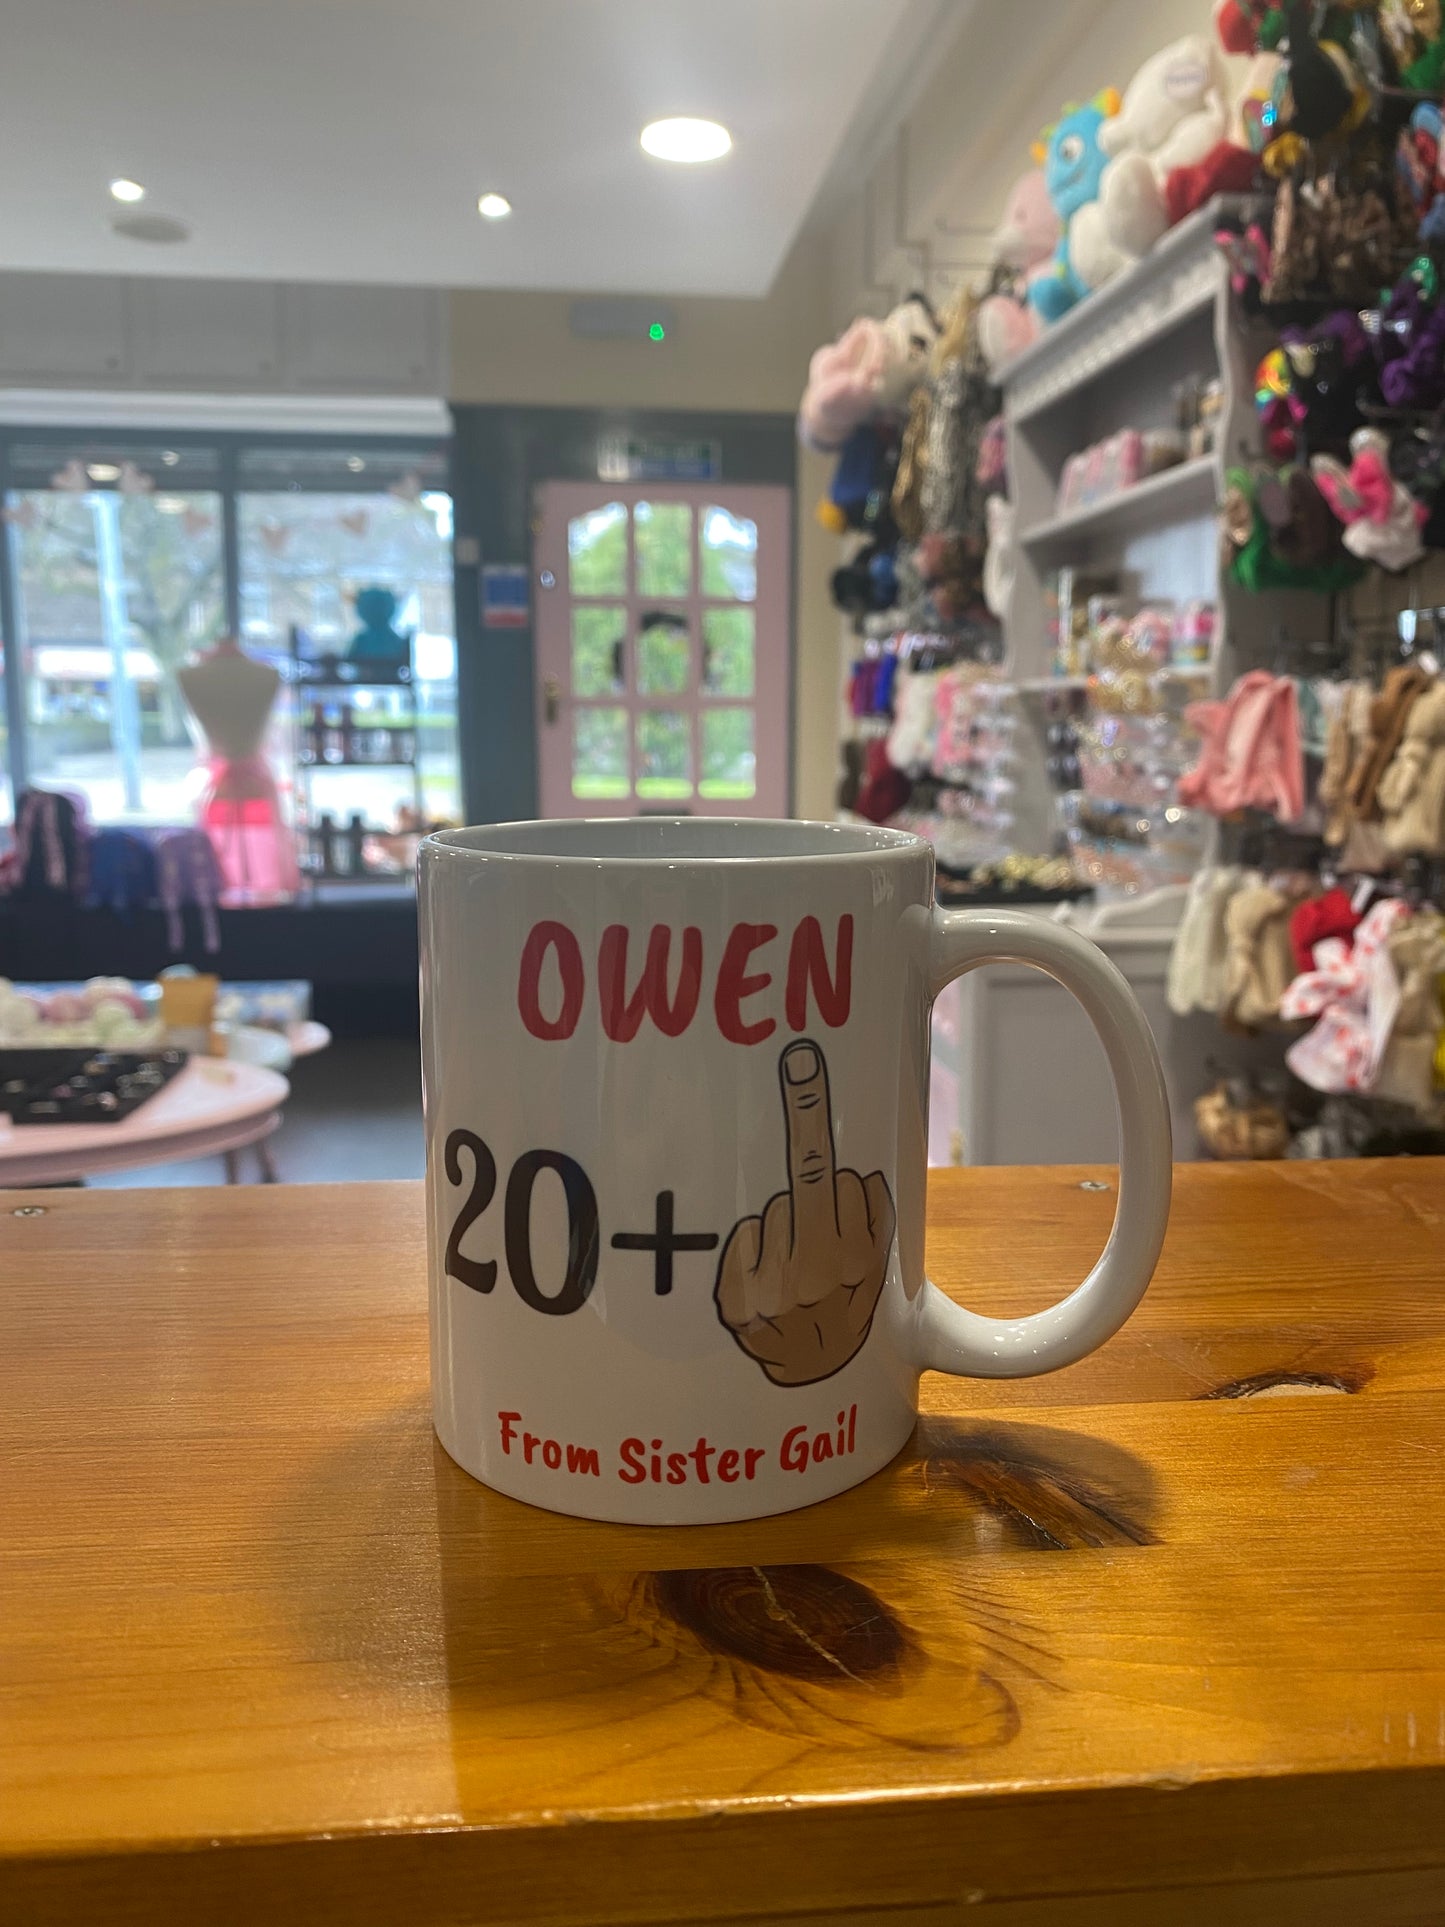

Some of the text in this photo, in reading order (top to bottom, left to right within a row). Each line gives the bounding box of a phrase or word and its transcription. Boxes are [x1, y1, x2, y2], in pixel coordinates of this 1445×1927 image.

[518, 913, 853, 1046] OWEN
[498, 1403, 858, 1486] From Sister Gail
